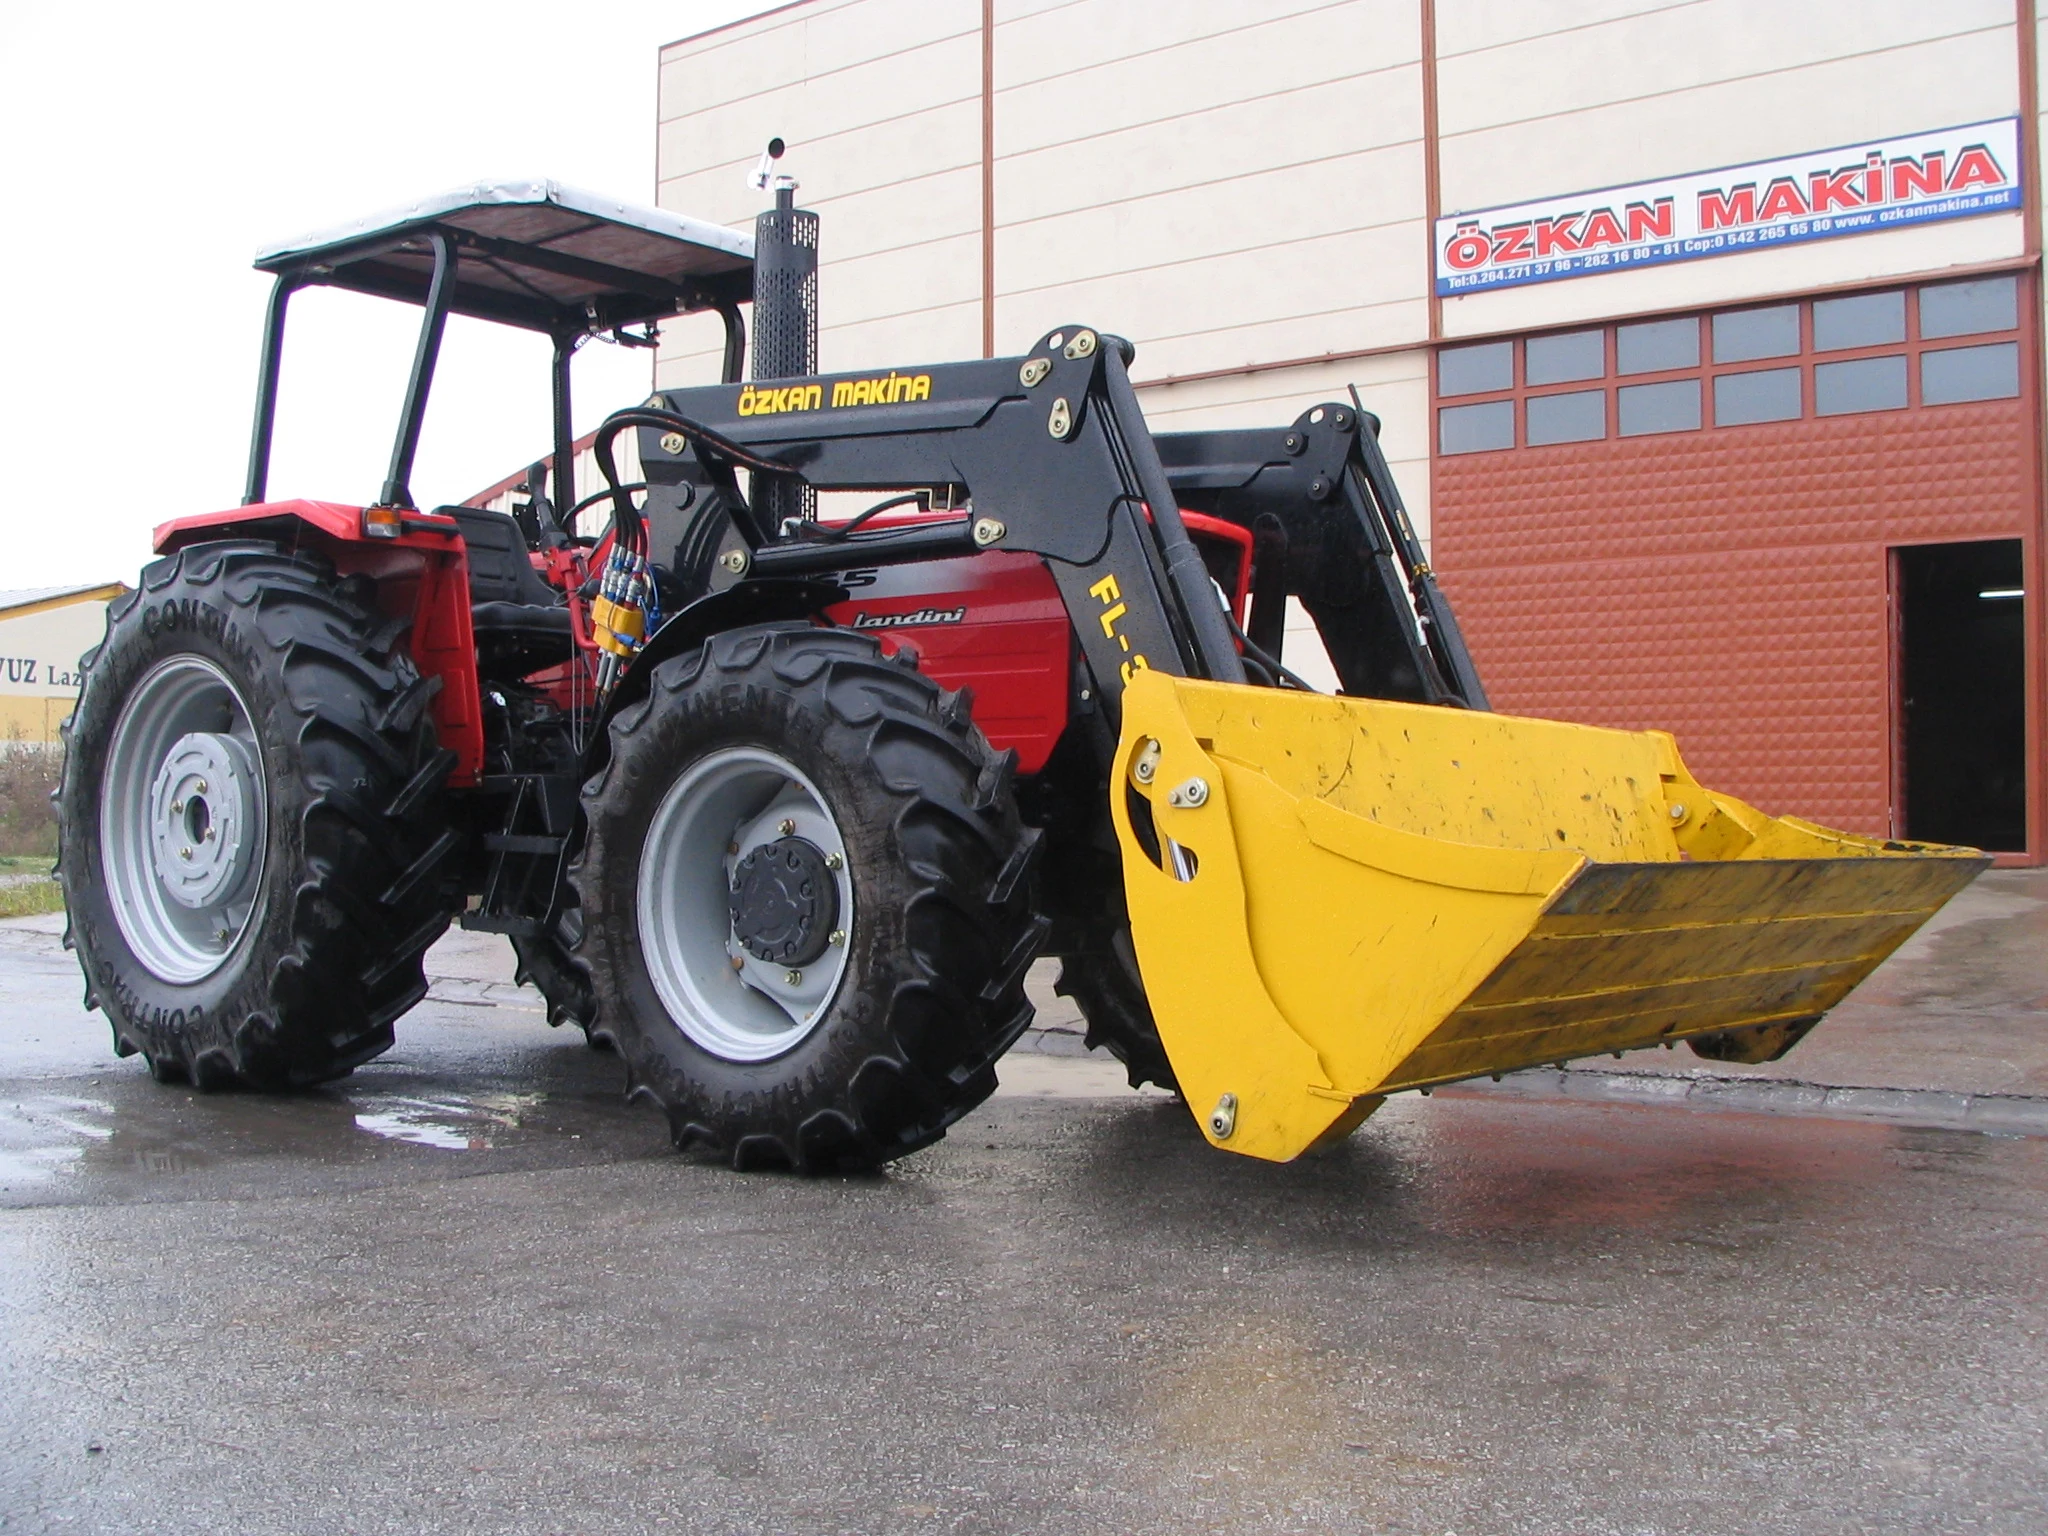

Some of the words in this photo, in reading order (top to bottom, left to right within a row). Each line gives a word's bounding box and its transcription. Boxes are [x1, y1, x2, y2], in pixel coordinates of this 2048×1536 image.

[1444, 198, 1674, 271] ÖZKAN
[1699, 144, 2007, 232] MAKİNA
[1535, 262, 1550, 275] 37
[1613, 252, 1628, 264] 16
[1664, 242, 1680, 255] 81
[1728, 232, 1755, 245] 542
[1759, 227, 1786, 240] 265
[1790, 222, 1808, 235] 65
[1813, 219, 1831, 232] 80
[1880, 191, 2010, 222] ozkanmakina.net
[738, 385, 822, 416] ÖZKAN
[852, 607, 966, 630] Landini
